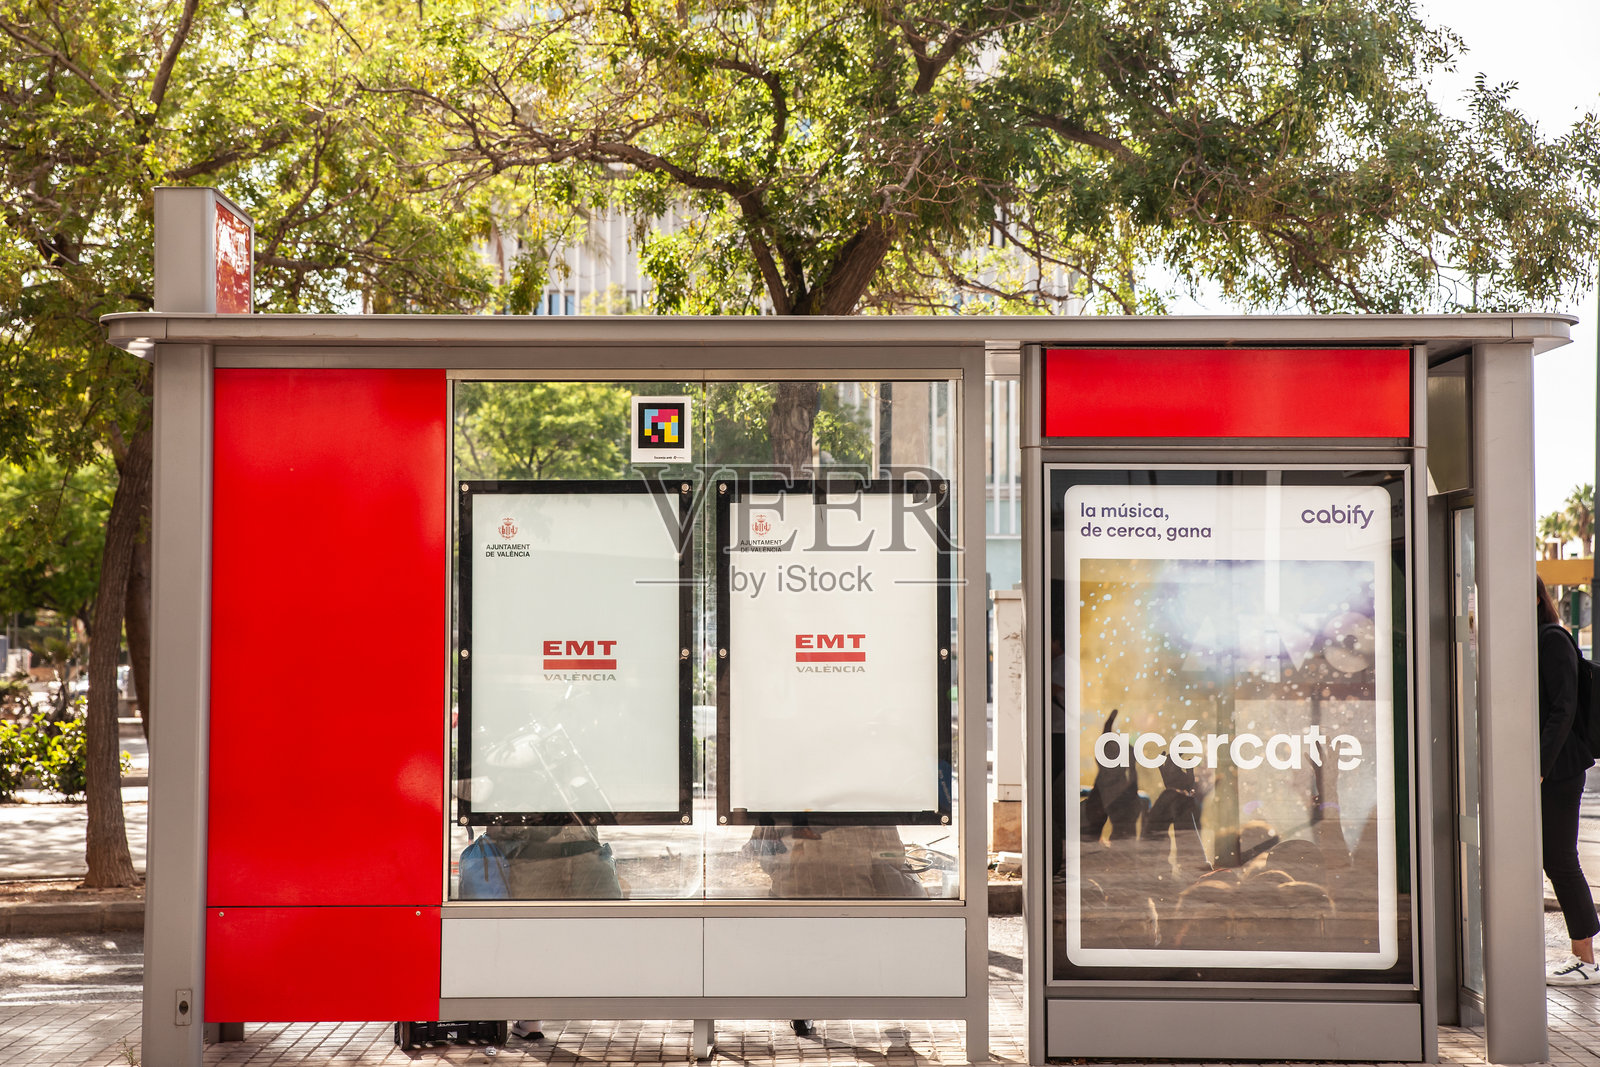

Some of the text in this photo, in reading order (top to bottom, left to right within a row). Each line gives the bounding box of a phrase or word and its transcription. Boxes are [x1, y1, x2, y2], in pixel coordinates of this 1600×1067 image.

[1080, 502, 1170, 521] la música,
[1301, 505, 1375, 529] cabify
[1080, 522, 1212, 542] de cerca, gana
[543, 640, 617, 656] EMT
[795, 634, 866, 649] EMT
[543, 671, 617, 681] VALÈNCIA
[796, 663, 866, 673] VALÈNCIA
[1094, 719, 1363, 770] acércate
